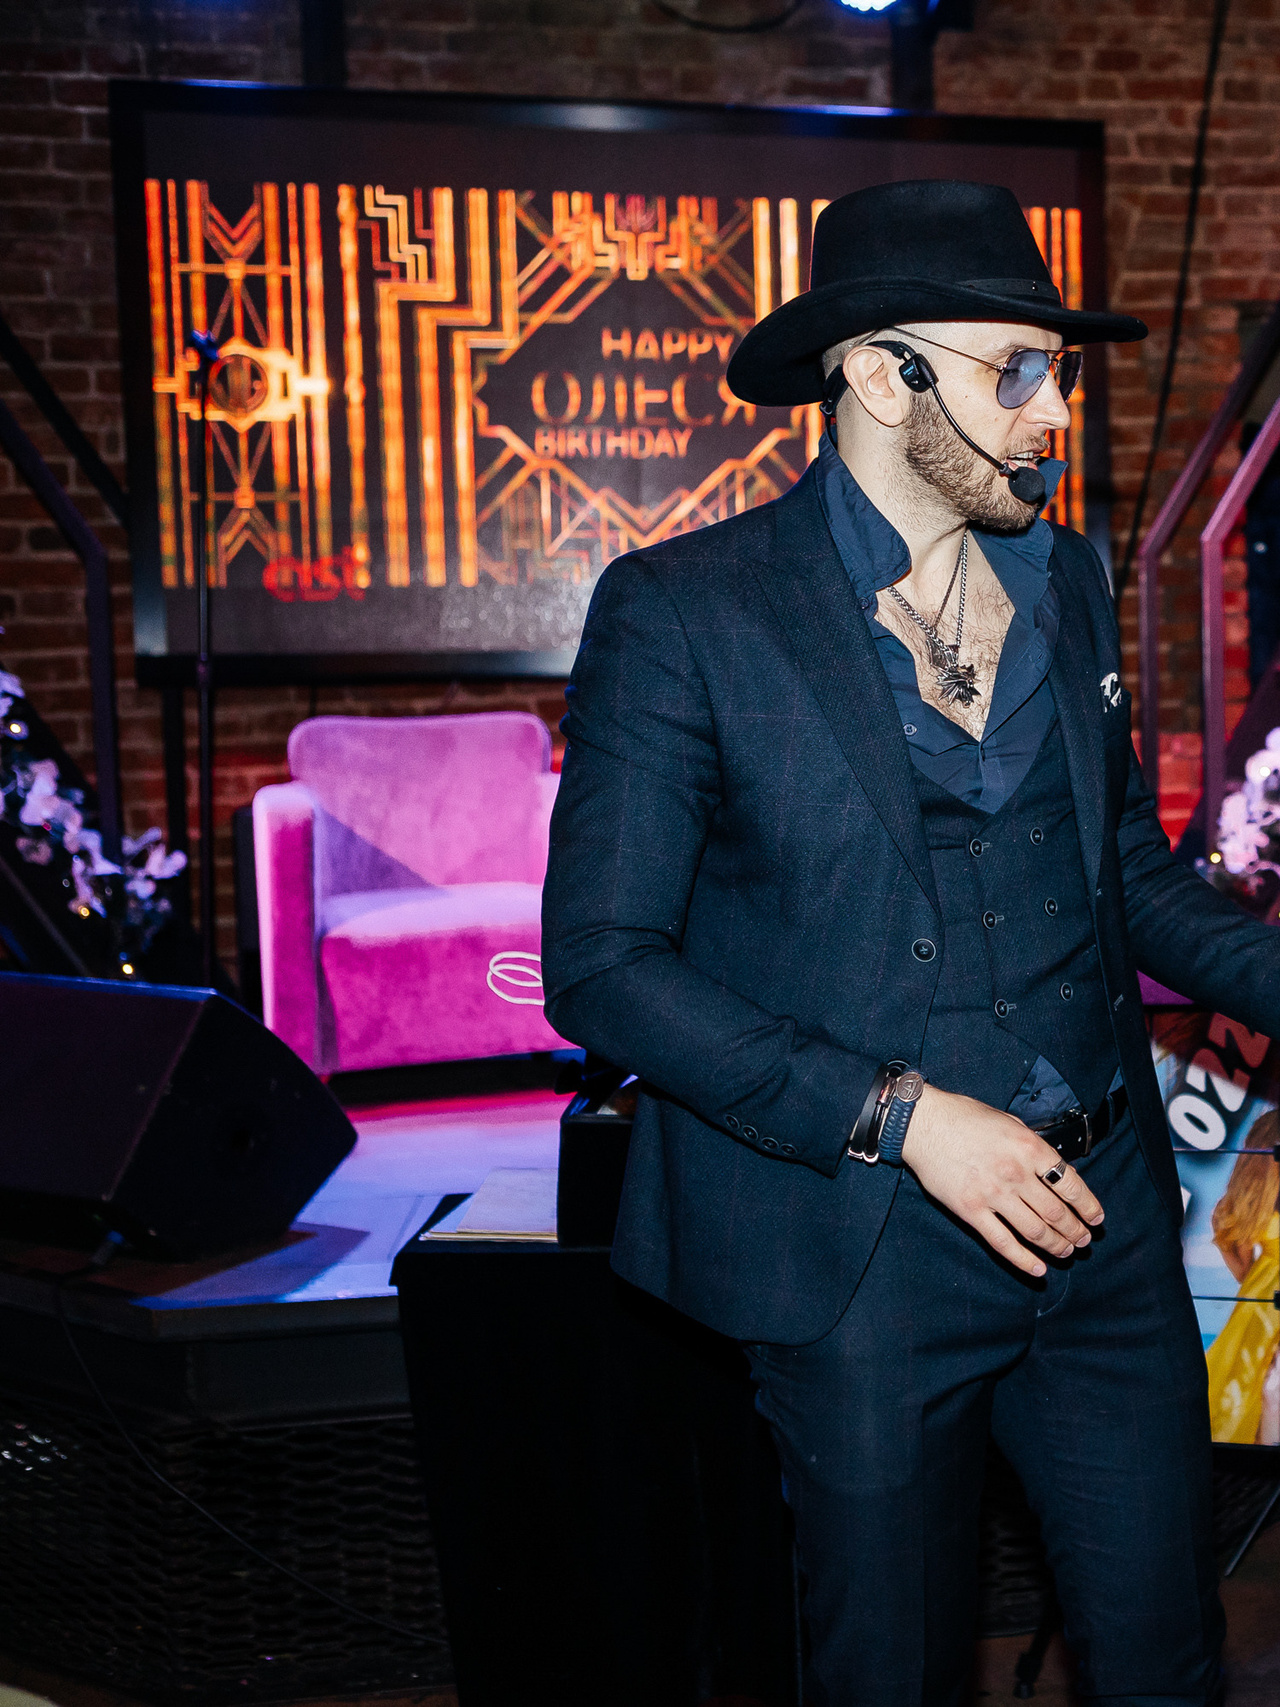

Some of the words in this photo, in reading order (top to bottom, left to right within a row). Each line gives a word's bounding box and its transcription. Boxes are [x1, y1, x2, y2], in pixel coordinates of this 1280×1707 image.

[602, 326, 733, 363] HAPPY
[534, 426, 693, 459] BIRTHDAY
[1168, 1012, 1271, 1214] 022
